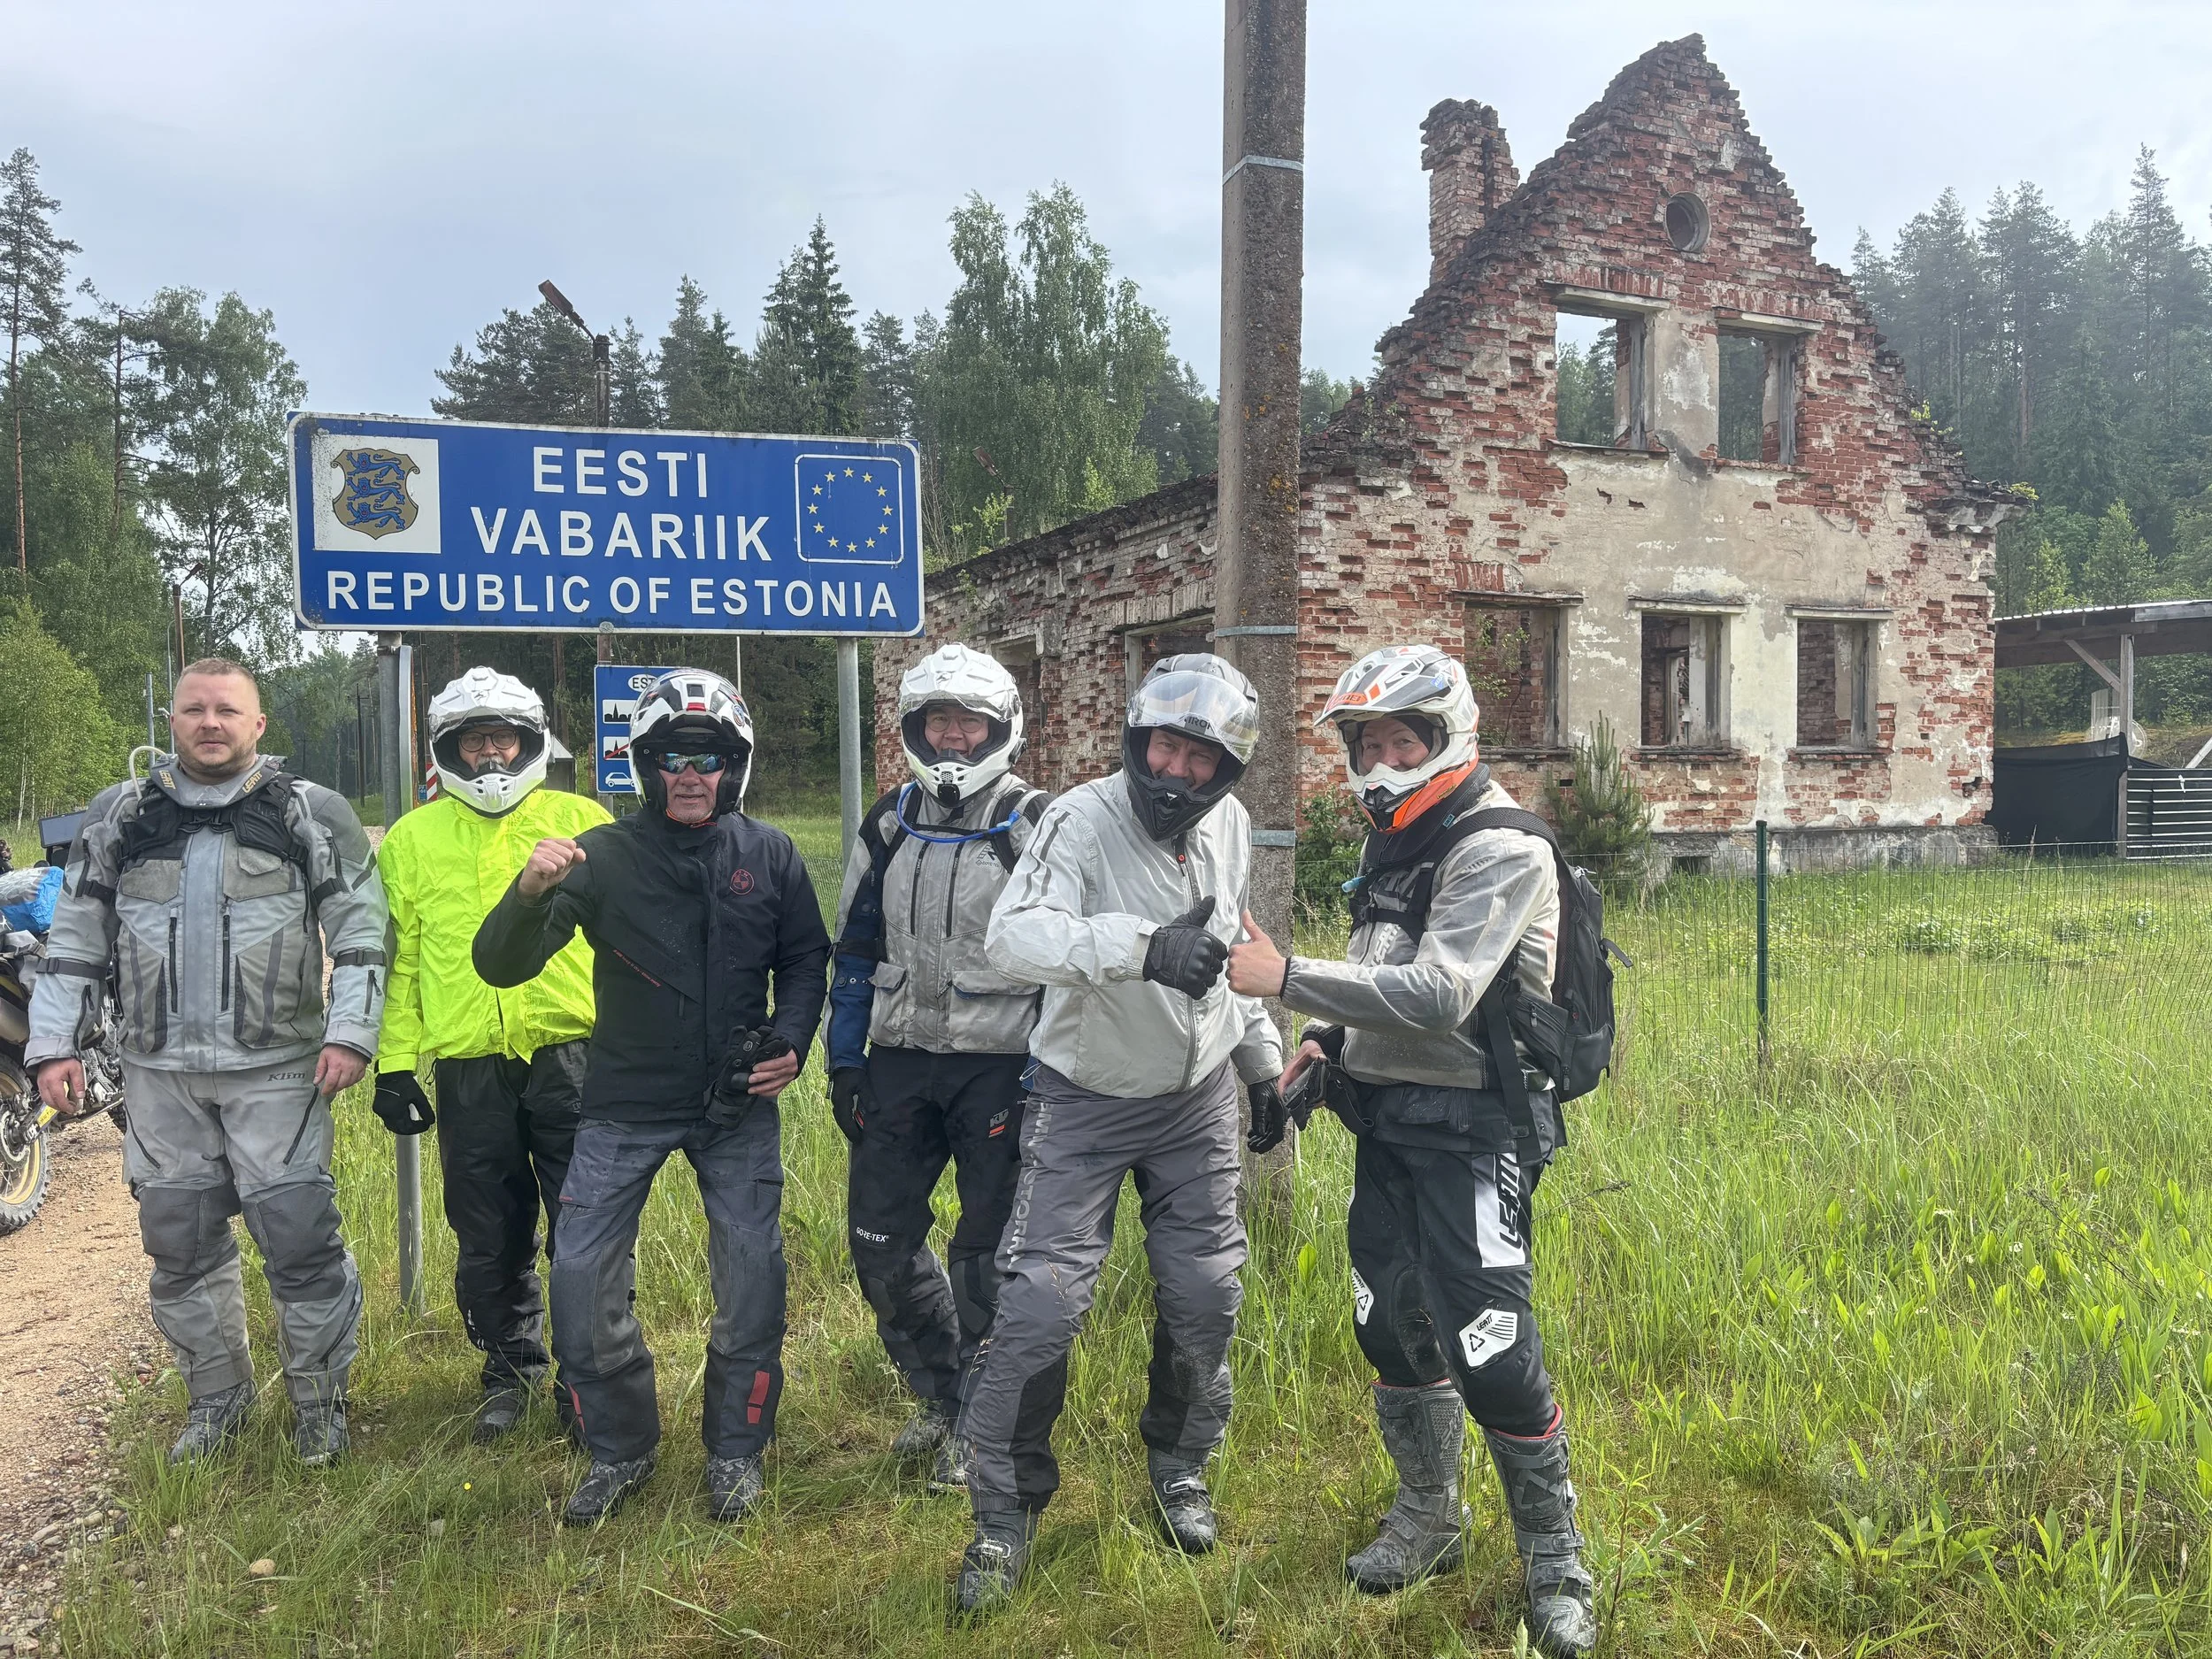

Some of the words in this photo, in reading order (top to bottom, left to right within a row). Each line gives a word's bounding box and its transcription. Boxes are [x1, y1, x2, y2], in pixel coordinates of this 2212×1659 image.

[534, 446, 707, 498] EESTI
[471, 506, 772, 561] VABARIIK
[327, 571, 590, 612] REPUBLIC
[610, 576, 671, 614] OF
[690, 578, 897, 618] ESTONIA
[242, 771, 263, 794] LEATT
[1476, 1312, 1493, 1332] LEATT
